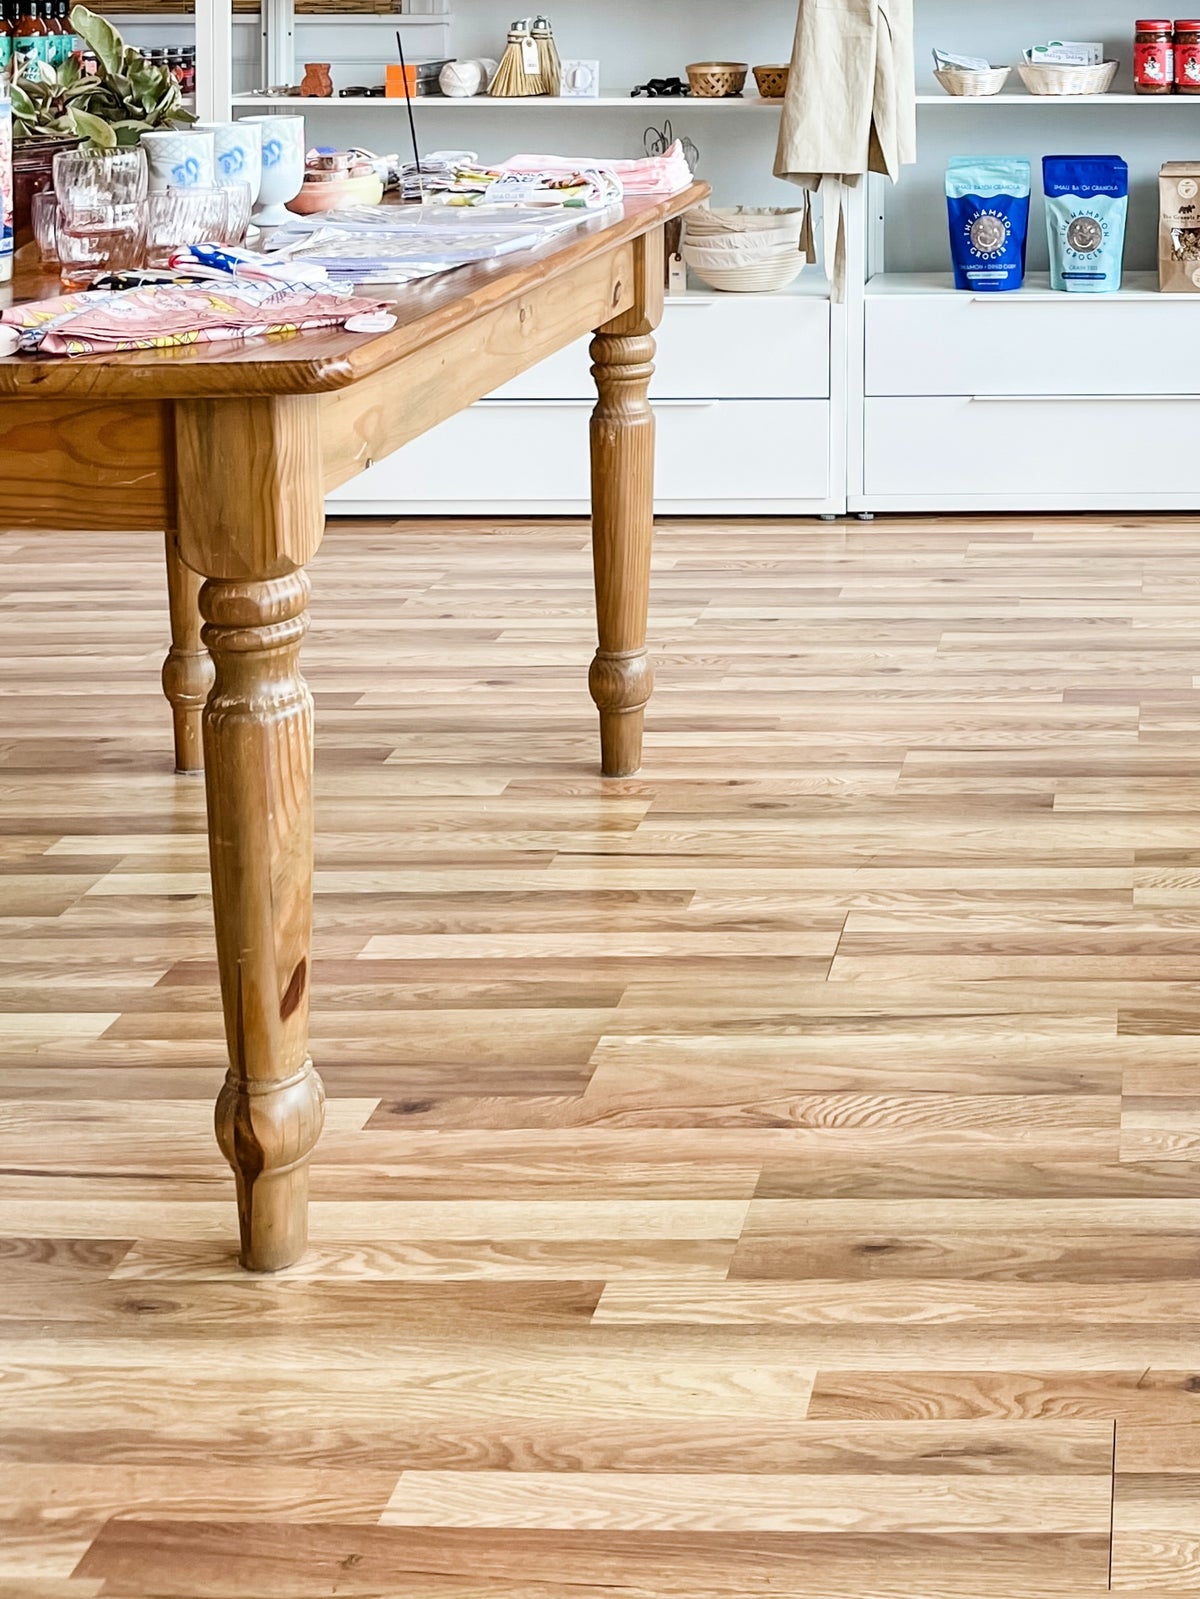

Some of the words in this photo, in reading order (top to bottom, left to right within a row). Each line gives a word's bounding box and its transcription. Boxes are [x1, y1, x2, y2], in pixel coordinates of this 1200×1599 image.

[964, 219, 973, 236] THE
[974, 209, 1011, 236] HAMPTON
[1060, 219, 1070, 236] THE
[1071, 210, 1110, 237] HAMPTON
[969, 247, 1007, 261] GROCER
[1066, 248, 1103, 261] GROCER
